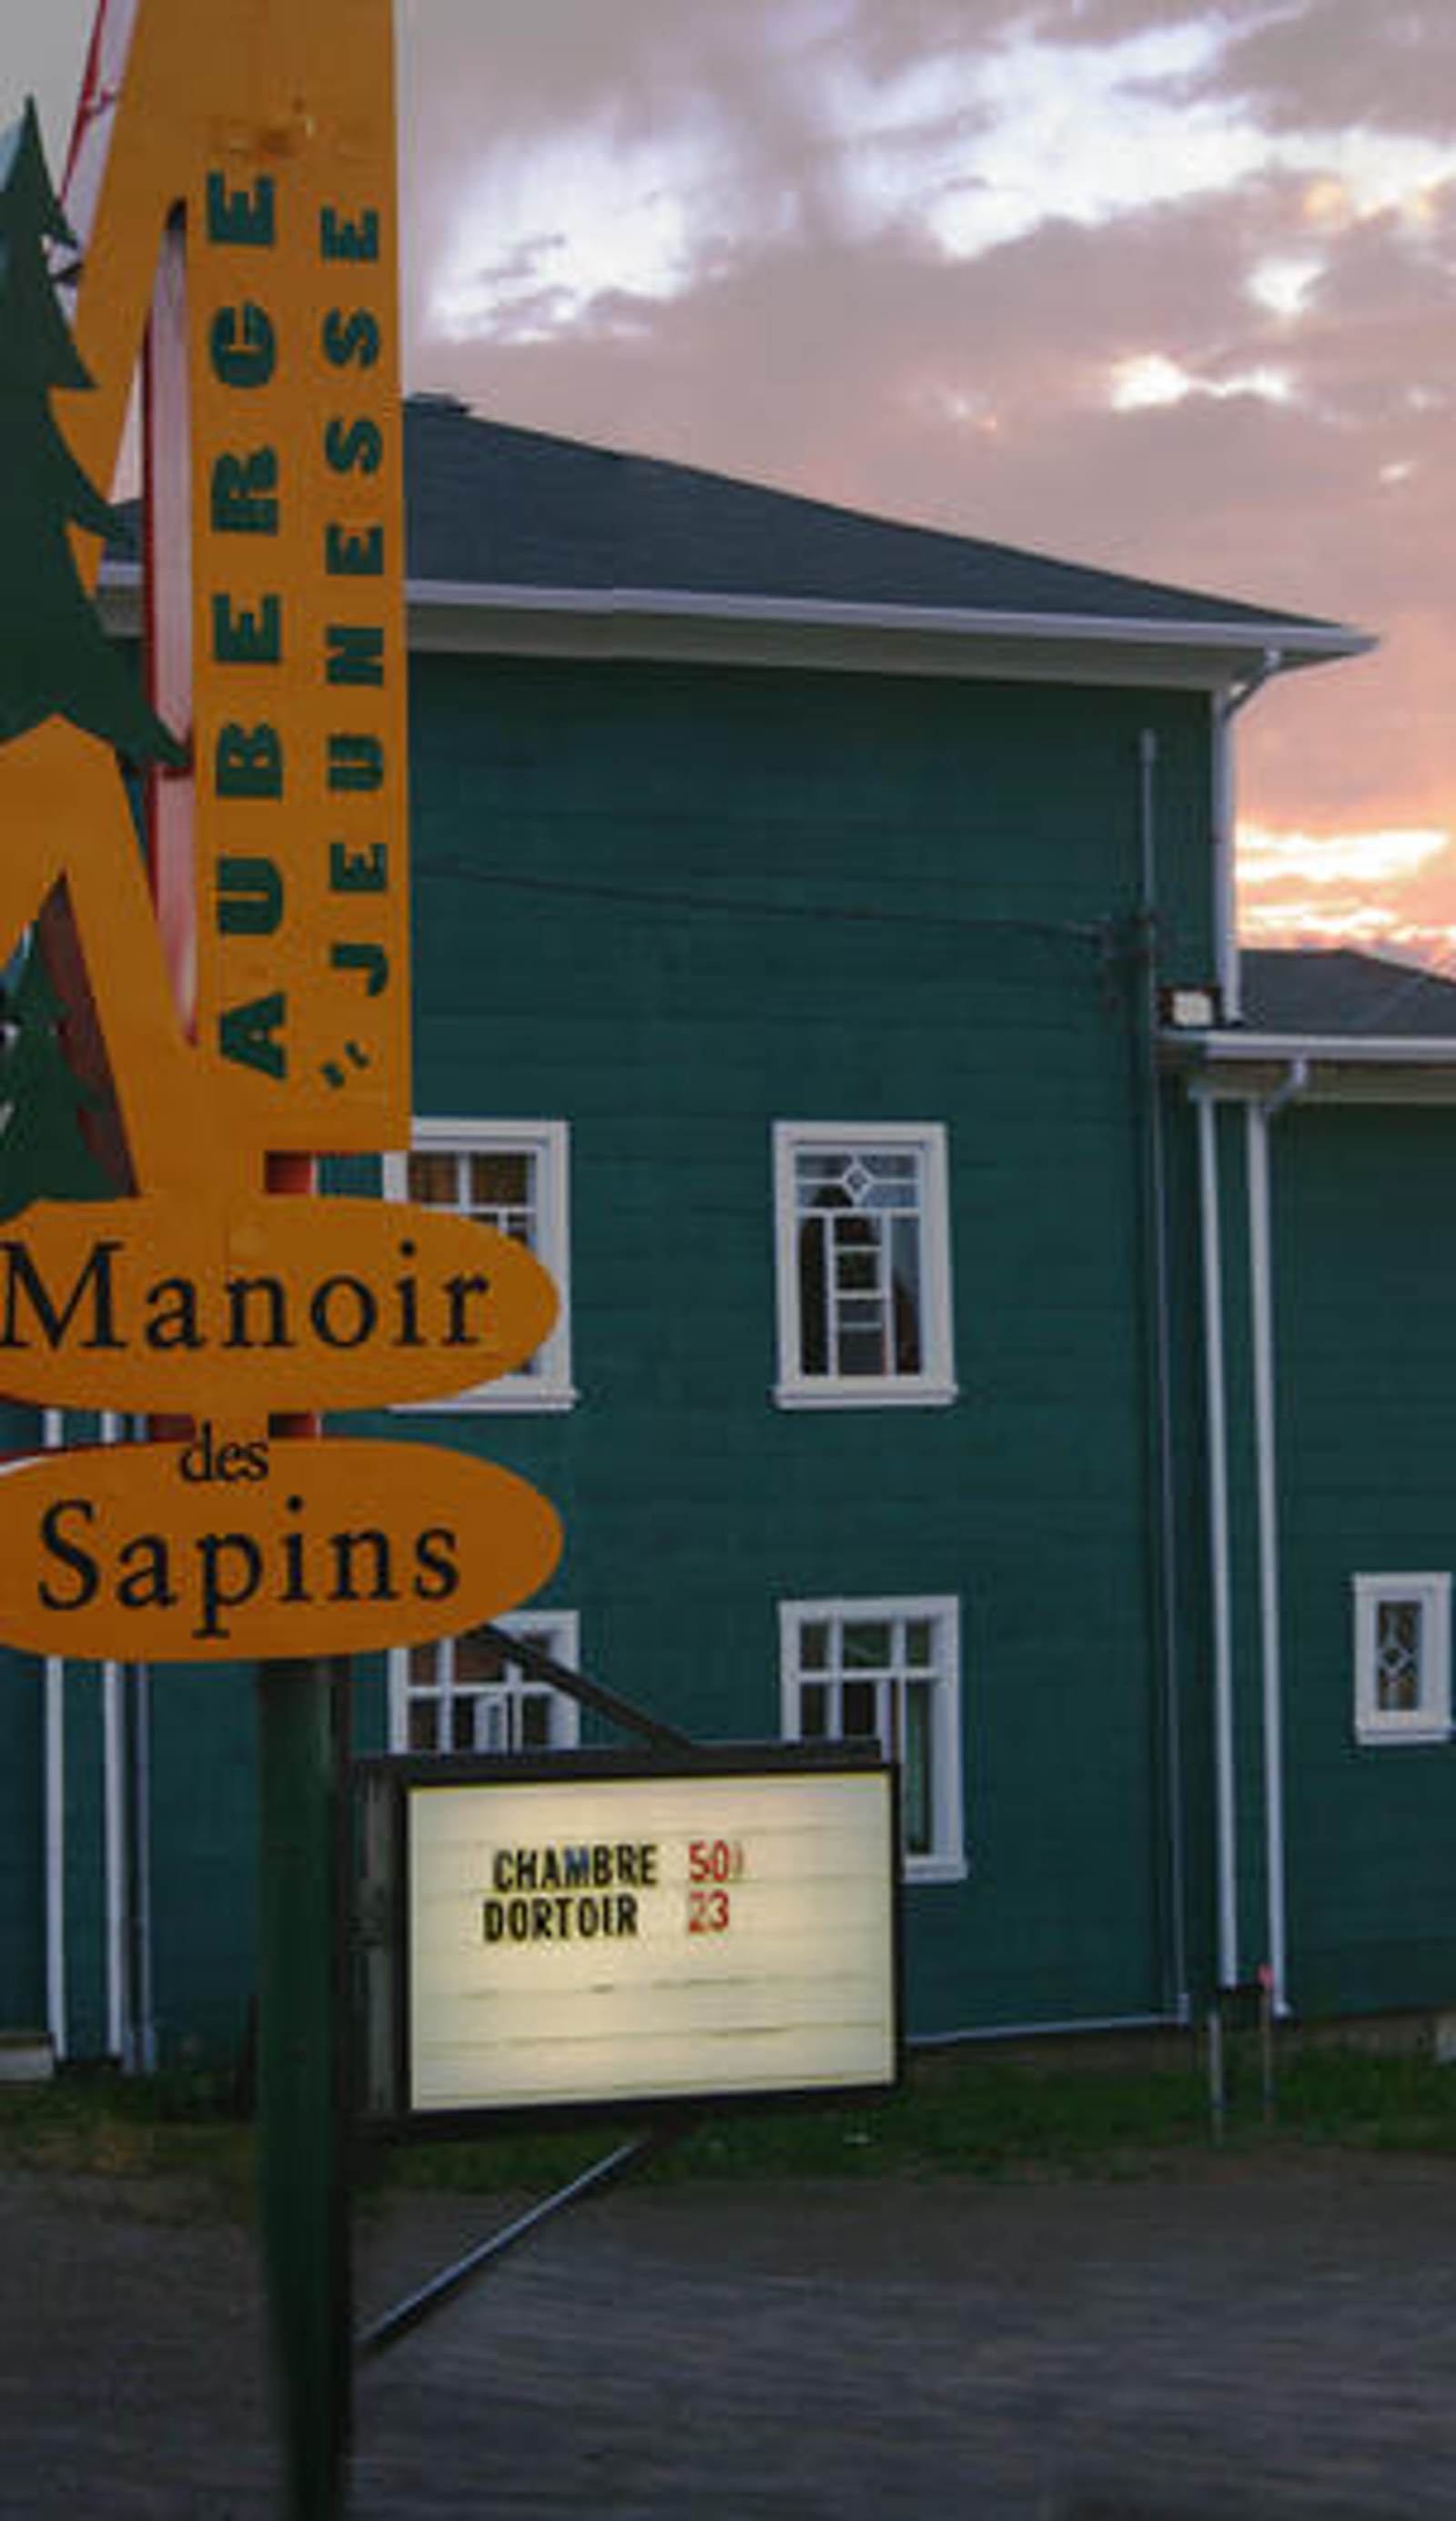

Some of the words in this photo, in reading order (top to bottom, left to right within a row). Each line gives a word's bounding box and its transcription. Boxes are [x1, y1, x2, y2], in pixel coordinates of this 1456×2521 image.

[206, 169, 289, 1080] AUBERGE
[320, 206, 389, 997] JEUNESSE
[0, 1239, 490, 1351] Manoir
[180, 1420, 270, 1482] des
[37, 1494, 460, 1639] Sapins
[483, 1893, 639, 1942] DORTOIR
[492, 1844, 658, 1892] CHAMBRE
